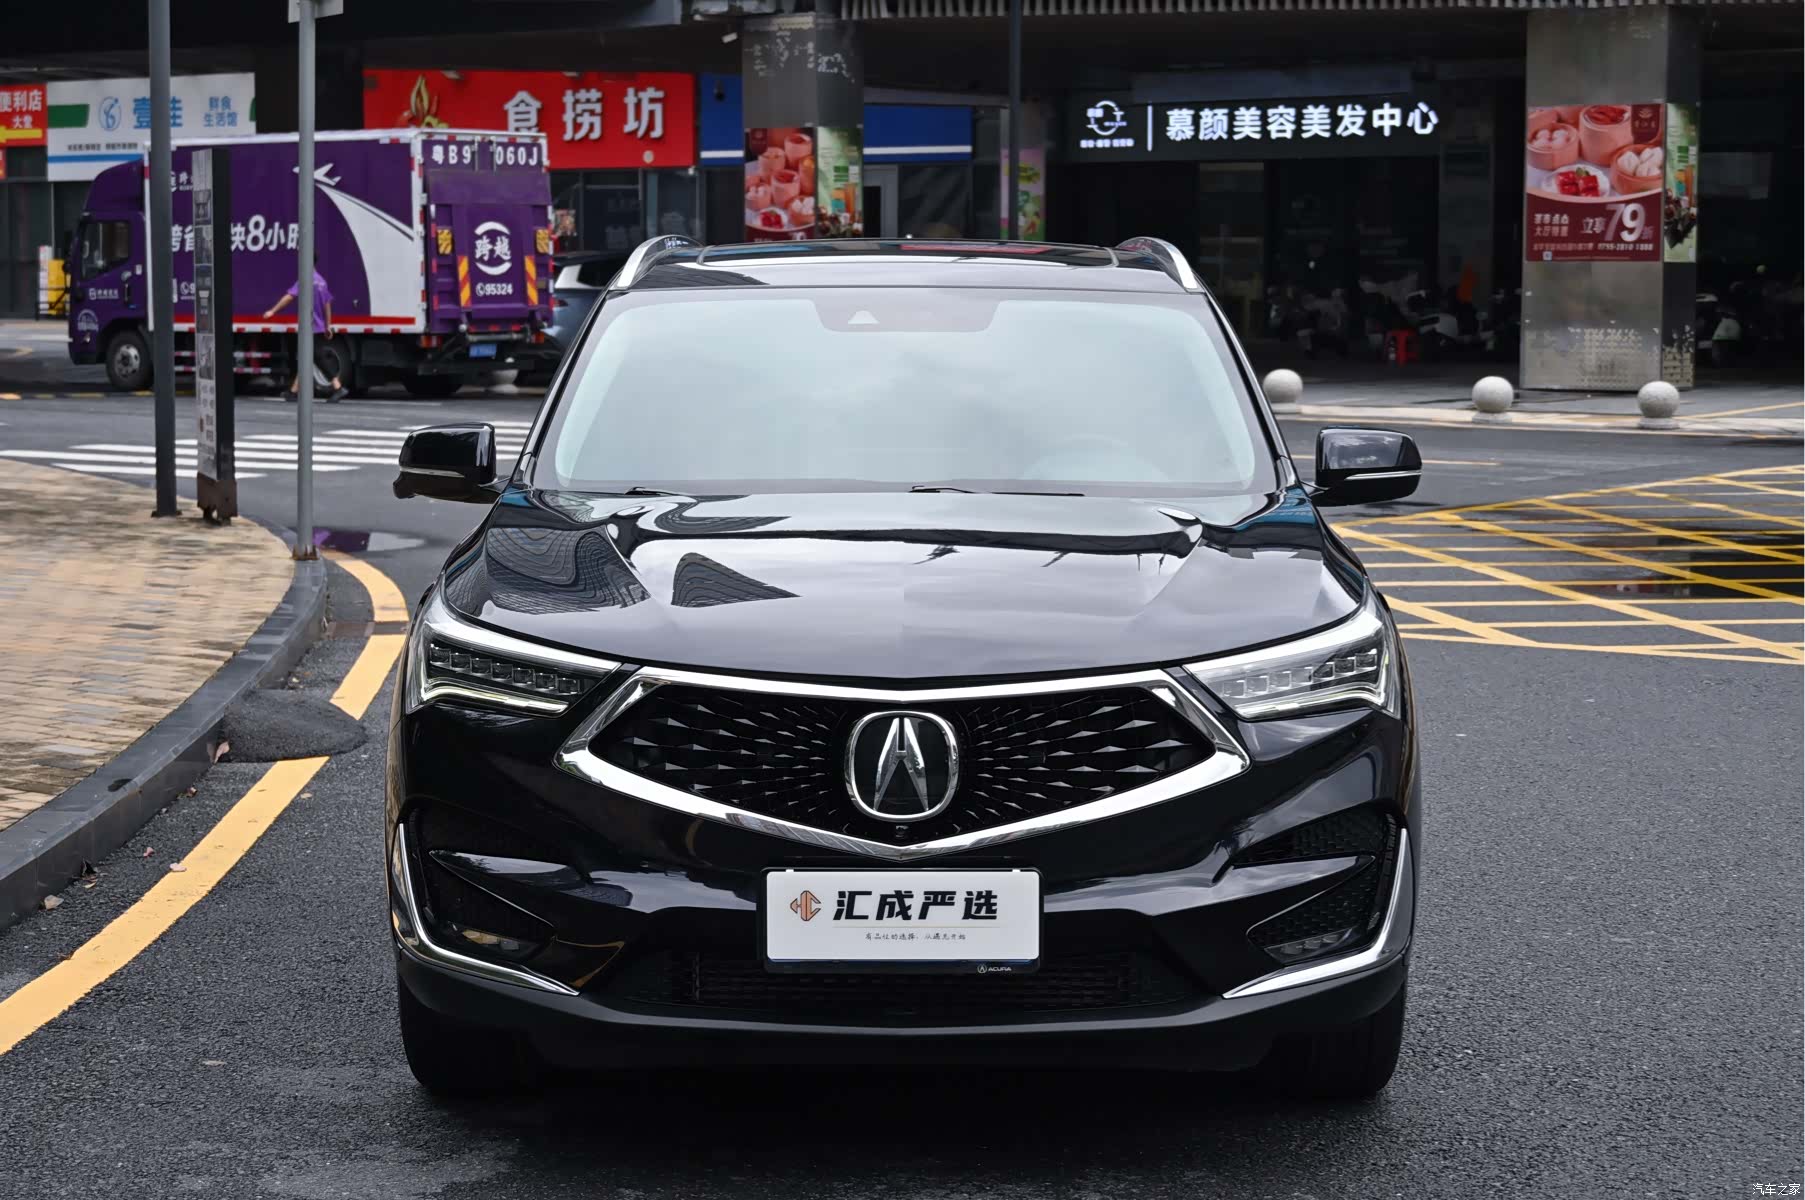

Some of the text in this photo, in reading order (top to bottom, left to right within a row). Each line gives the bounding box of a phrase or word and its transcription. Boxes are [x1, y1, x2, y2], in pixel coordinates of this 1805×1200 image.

[503, 87, 665, 142] 食捞坊
[1165, 102, 1439, 141] 慕颜美容美发中心
[474, 235, 512, 262] 跨越
[485, 283, 513, 296] 95324
[832, 890, 998, 921] 汇成严选
